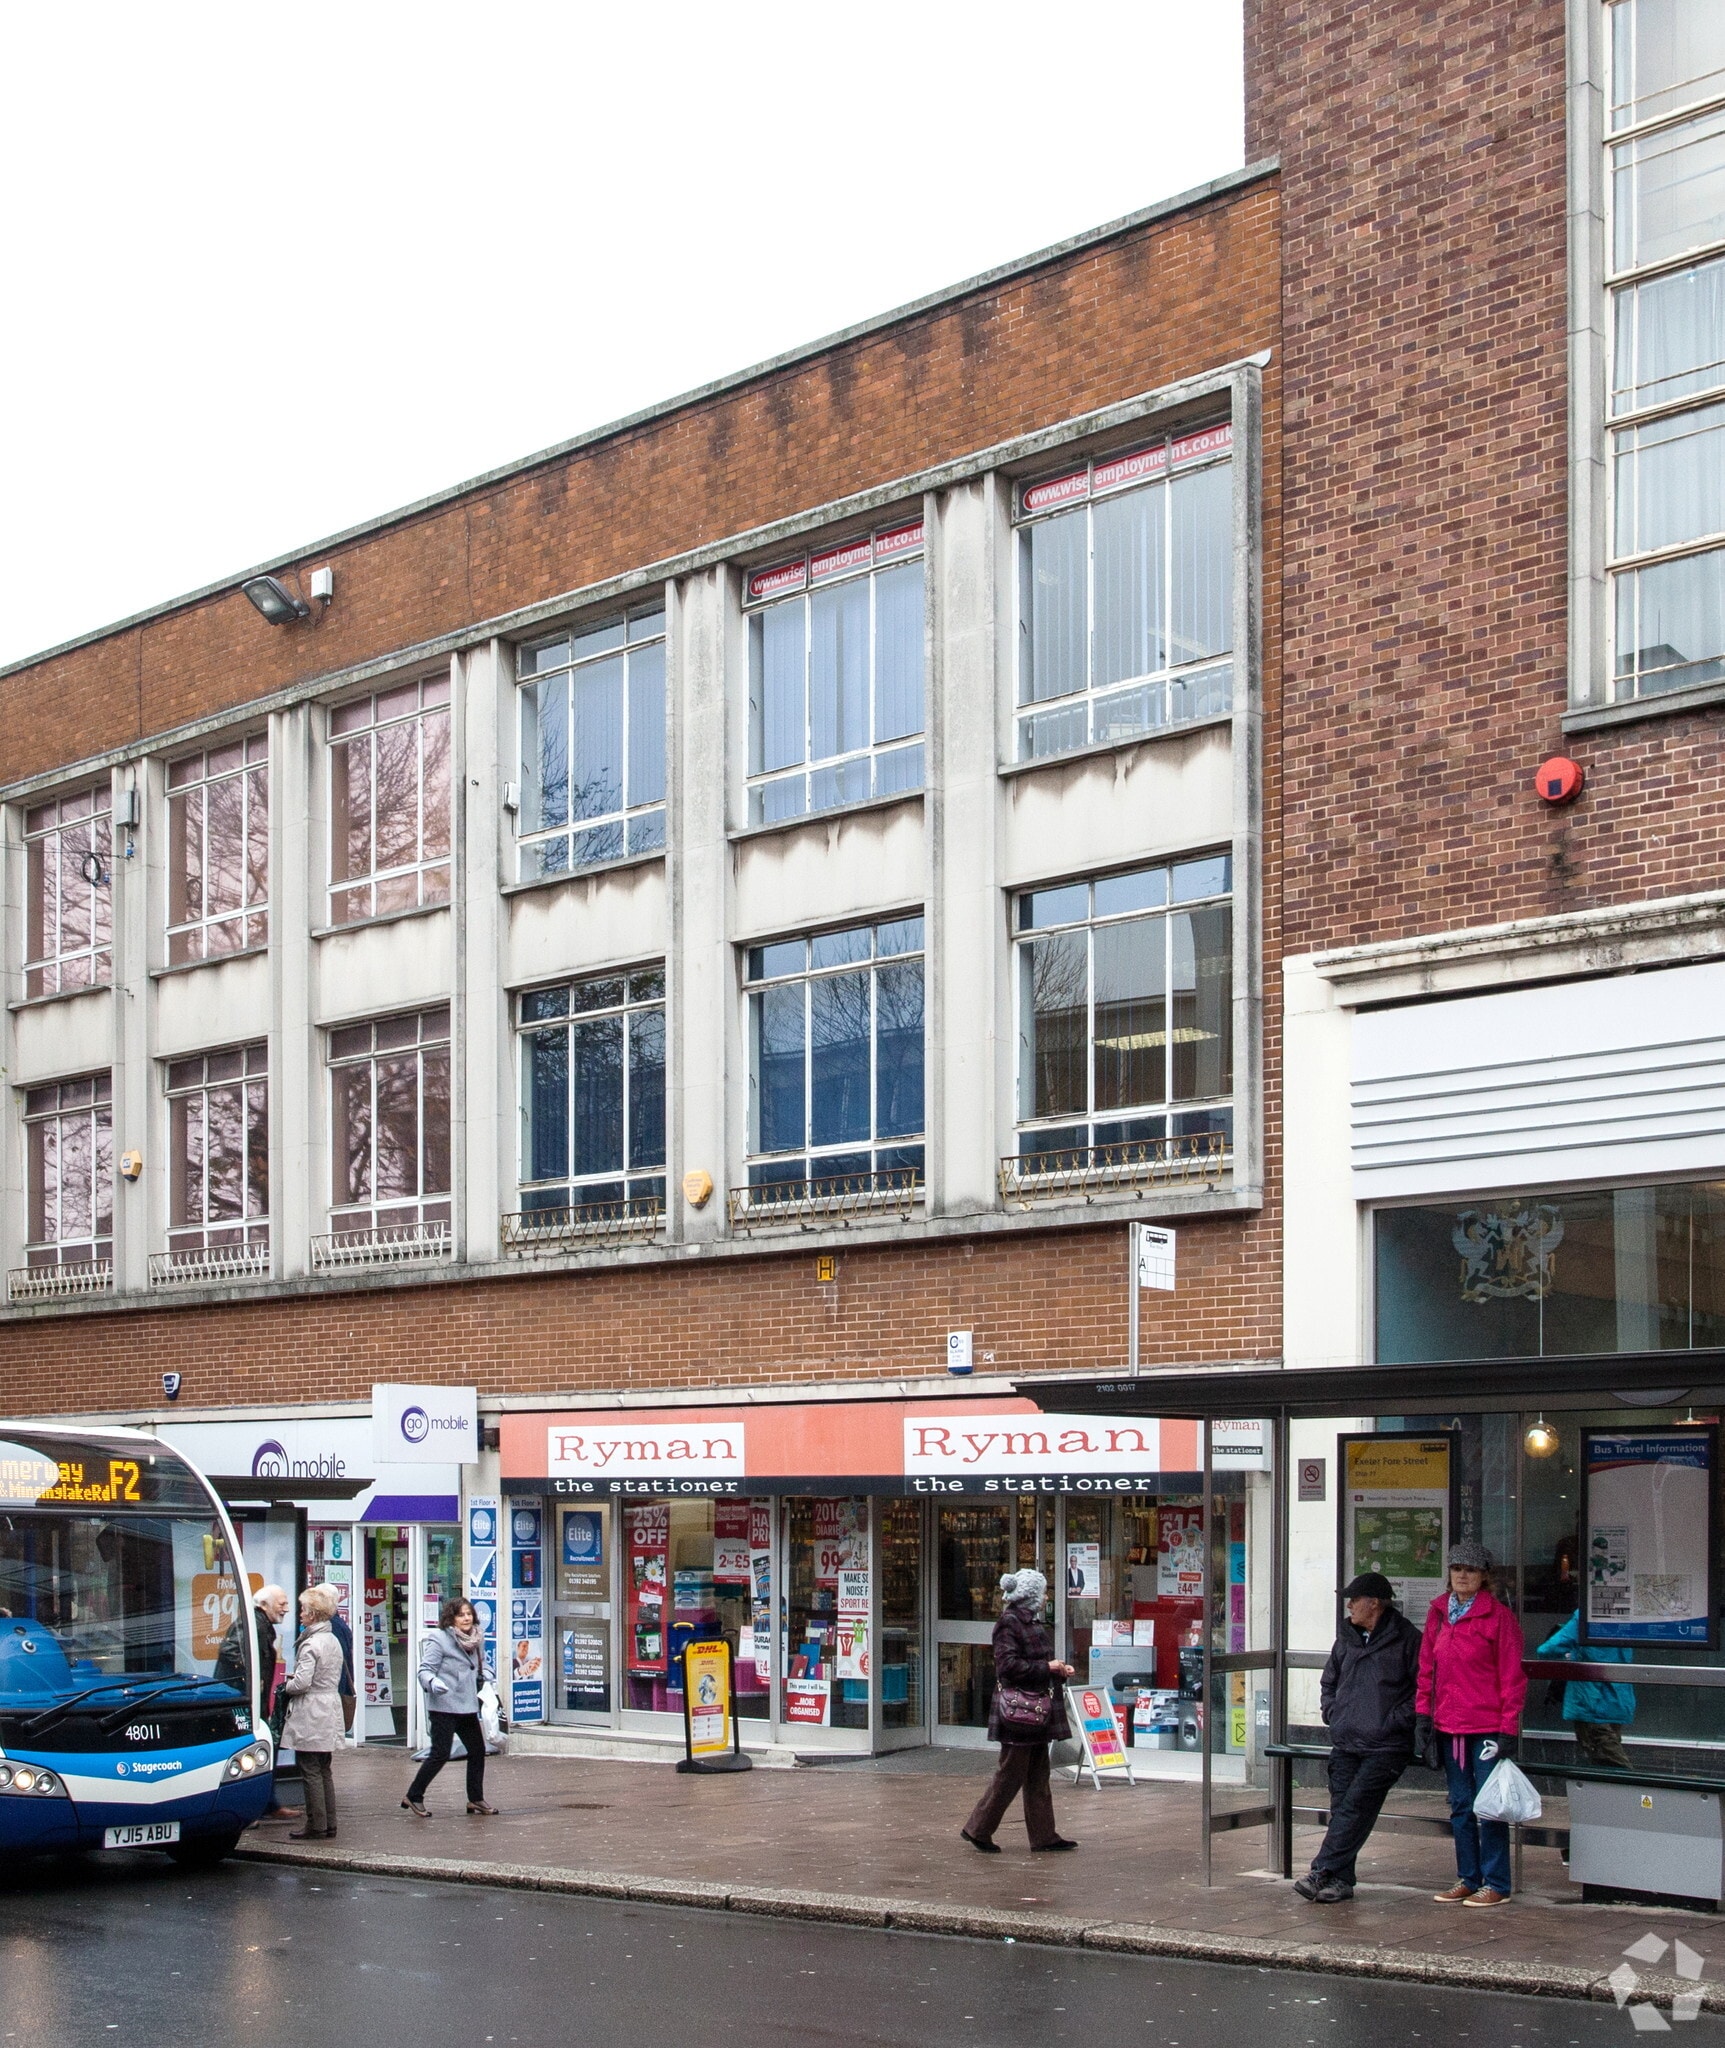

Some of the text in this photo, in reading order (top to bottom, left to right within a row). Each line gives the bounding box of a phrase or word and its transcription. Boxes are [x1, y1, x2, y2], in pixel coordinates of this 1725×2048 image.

[819, 1258, 832, 1280] H
[1138, 1257, 1146, 1269] A
[1096, 1384, 1115, 1392] 2102
[407, 1415, 469, 1432] go mobile
[1212, 1419, 1261, 1433] Ryman
[554, 1434, 738, 1468] Ryman
[912, 1427, 1150, 1463] Ryman
[1594, 1443, 1705, 1454] Bus Travel Information
[259, 1452, 346, 1478] go mobile
[1354, 1457, 1380, 1465] Exeter
[1404, 1457, 1428, 1465] Street
[109, 1460, 140, 1501] F2
[554, 1478, 738, 1492] the stationer
[912, 1475, 1151, 1492] the stationer
[633, 1505, 668, 1529] 25%
[815, 1503, 841, 1521] 2016
[473, 1520, 490, 1530] Elite
[516, 1520, 534, 1531] Elite
[752, 1513, 769, 1528] HA
[568, 1527, 592, 1541] Elite
[634, 1528, 667, 1545] OFF
[752, 1528, 769, 1542] PRI
[815, 1525, 840, 1537] DIARIE
[719, 1554, 727, 1568] 2
[734, 1554, 750, 1569] £5
[843, 1572, 861, 1583] MAKE
[365, 1588, 384, 1599] ALE
[470, 1589, 479, 1597] 2nd
[845, 1585, 869, 1596] NOISE F
[840, 1599, 869, 1609] SPORT RE
[203, 1593, 239, 1632] 99
[478, 1610, 490, 1621] ise
[754, 1634, 770, 1644] DURA
[697, 1645, 719, 1654] DHL
[790, 1706, 821, 1717] ORGANISED
[125, 1724, 160, 1741] 48011
[132, 1760, 182, 1774] Stagecoach
[113, 1824, 172, 1844] YJ15 ABU
